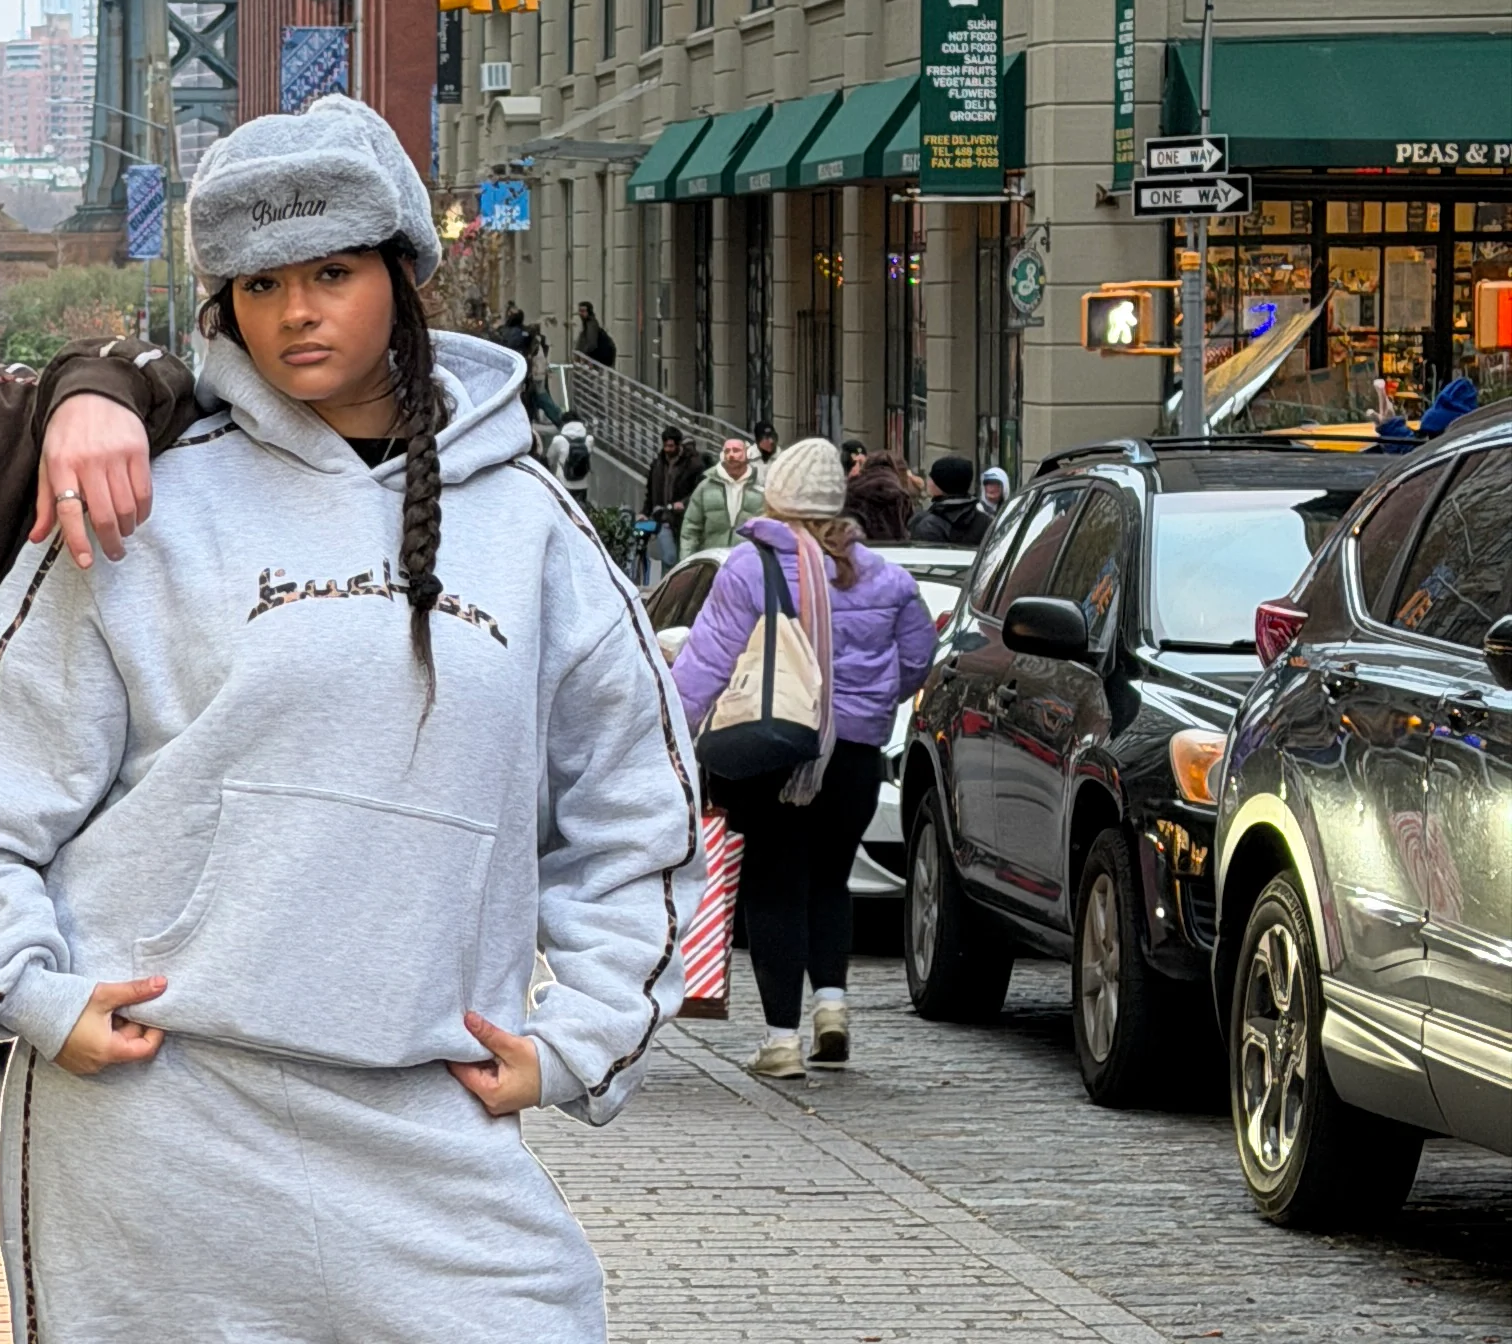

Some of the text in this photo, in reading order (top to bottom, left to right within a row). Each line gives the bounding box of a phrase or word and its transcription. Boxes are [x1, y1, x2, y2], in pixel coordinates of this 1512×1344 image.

[967, 19, 997, 30] SUSHI
[948, 31, 997, 42] HOT FOOD
[941, 42, 997, 53] COLD FOOD
[963, 54, 997, 64] SALAD
[926, 65, 997, 76] FRESH FRUITS
[933, 77, 997, 88] VEGETABLES
[948, 88, 997, 99] FLOWERS
[964, 99, 987, 110] DELI
[949, 111, 997, 122] GROCERY
[923, 135, 999, 146] FREE DELIVERY
[1156, 149, 1214, 165] ONE WAY
[1395, 142, 1459, 164] PEAS
[1465, 143, 1488, 164] &
[1150, 188, 1232, 204] ONE WAY
[252, 189, 327, 232] Buchan
